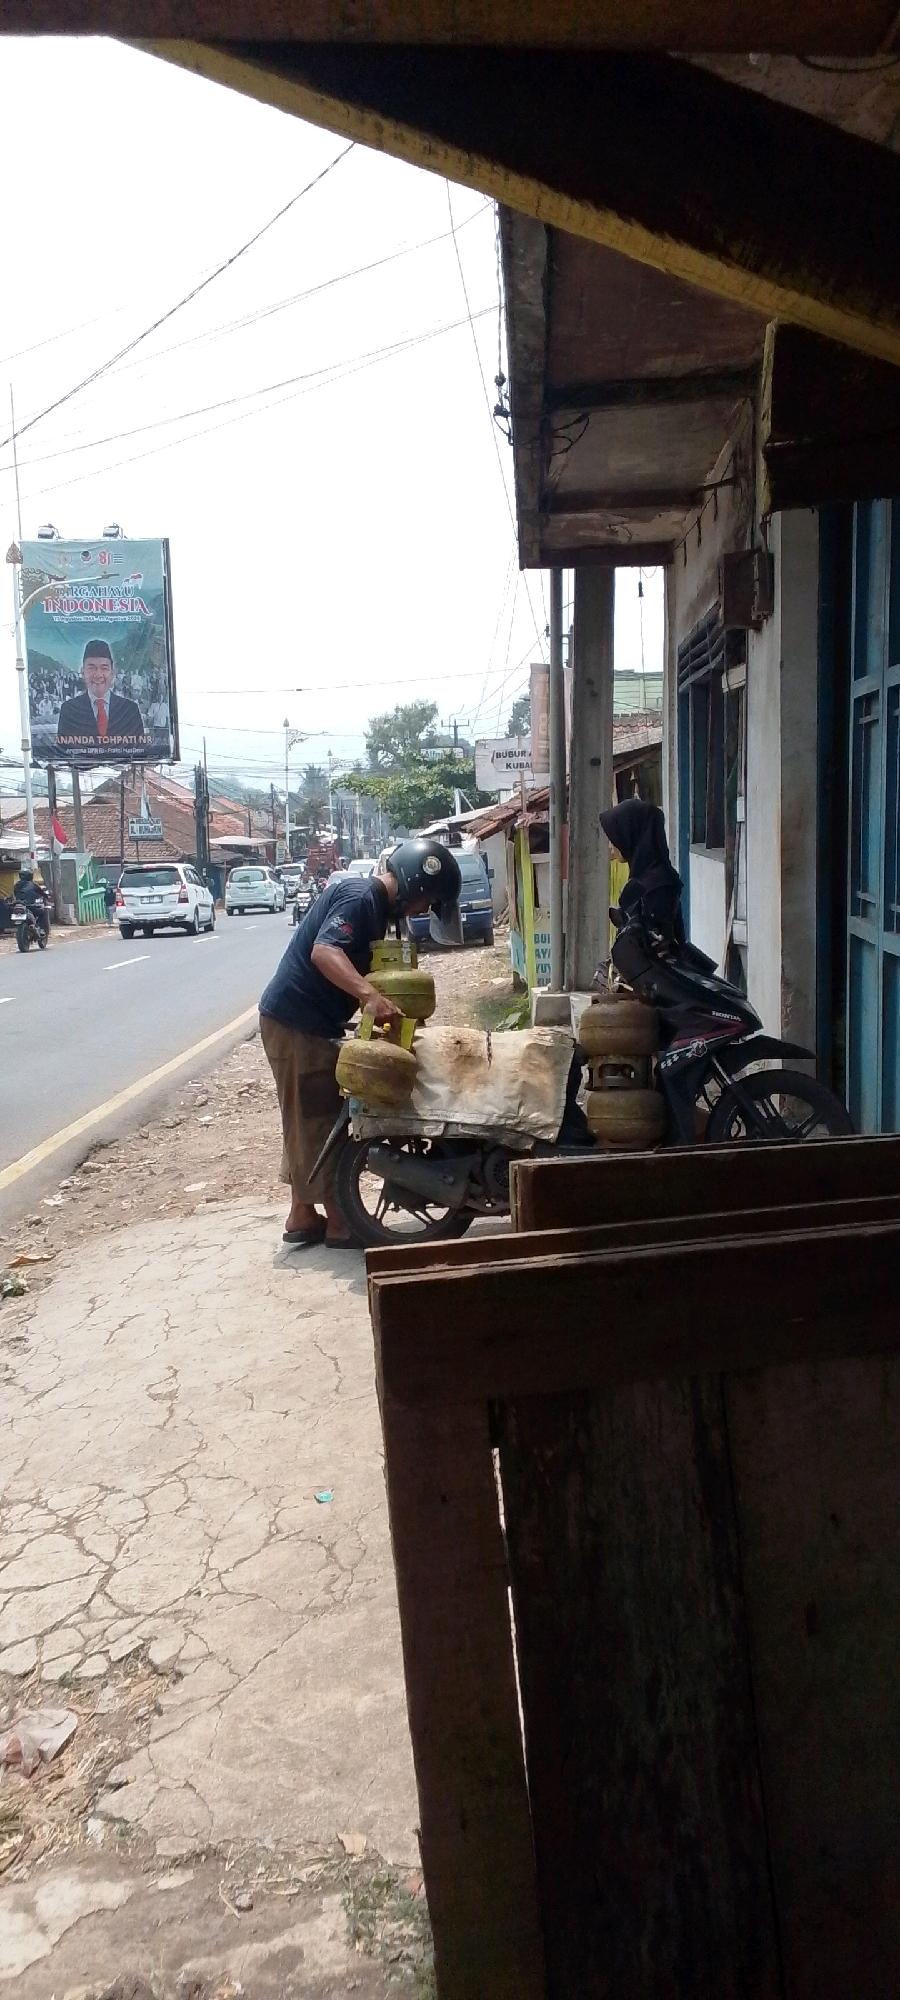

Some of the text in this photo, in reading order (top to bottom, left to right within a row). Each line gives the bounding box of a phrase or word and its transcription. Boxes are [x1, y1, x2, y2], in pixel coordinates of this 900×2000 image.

[43, 597, 152, 615] INDONESIA
[55, 735, 95, 744] ANANDA
[97, 735, 136, 744] TOHPATI
[496, 750, 527, 758] BUBUR
[505, 761, 532, 769] KUBA
[711, 1010, 741, 1021] HONDA
